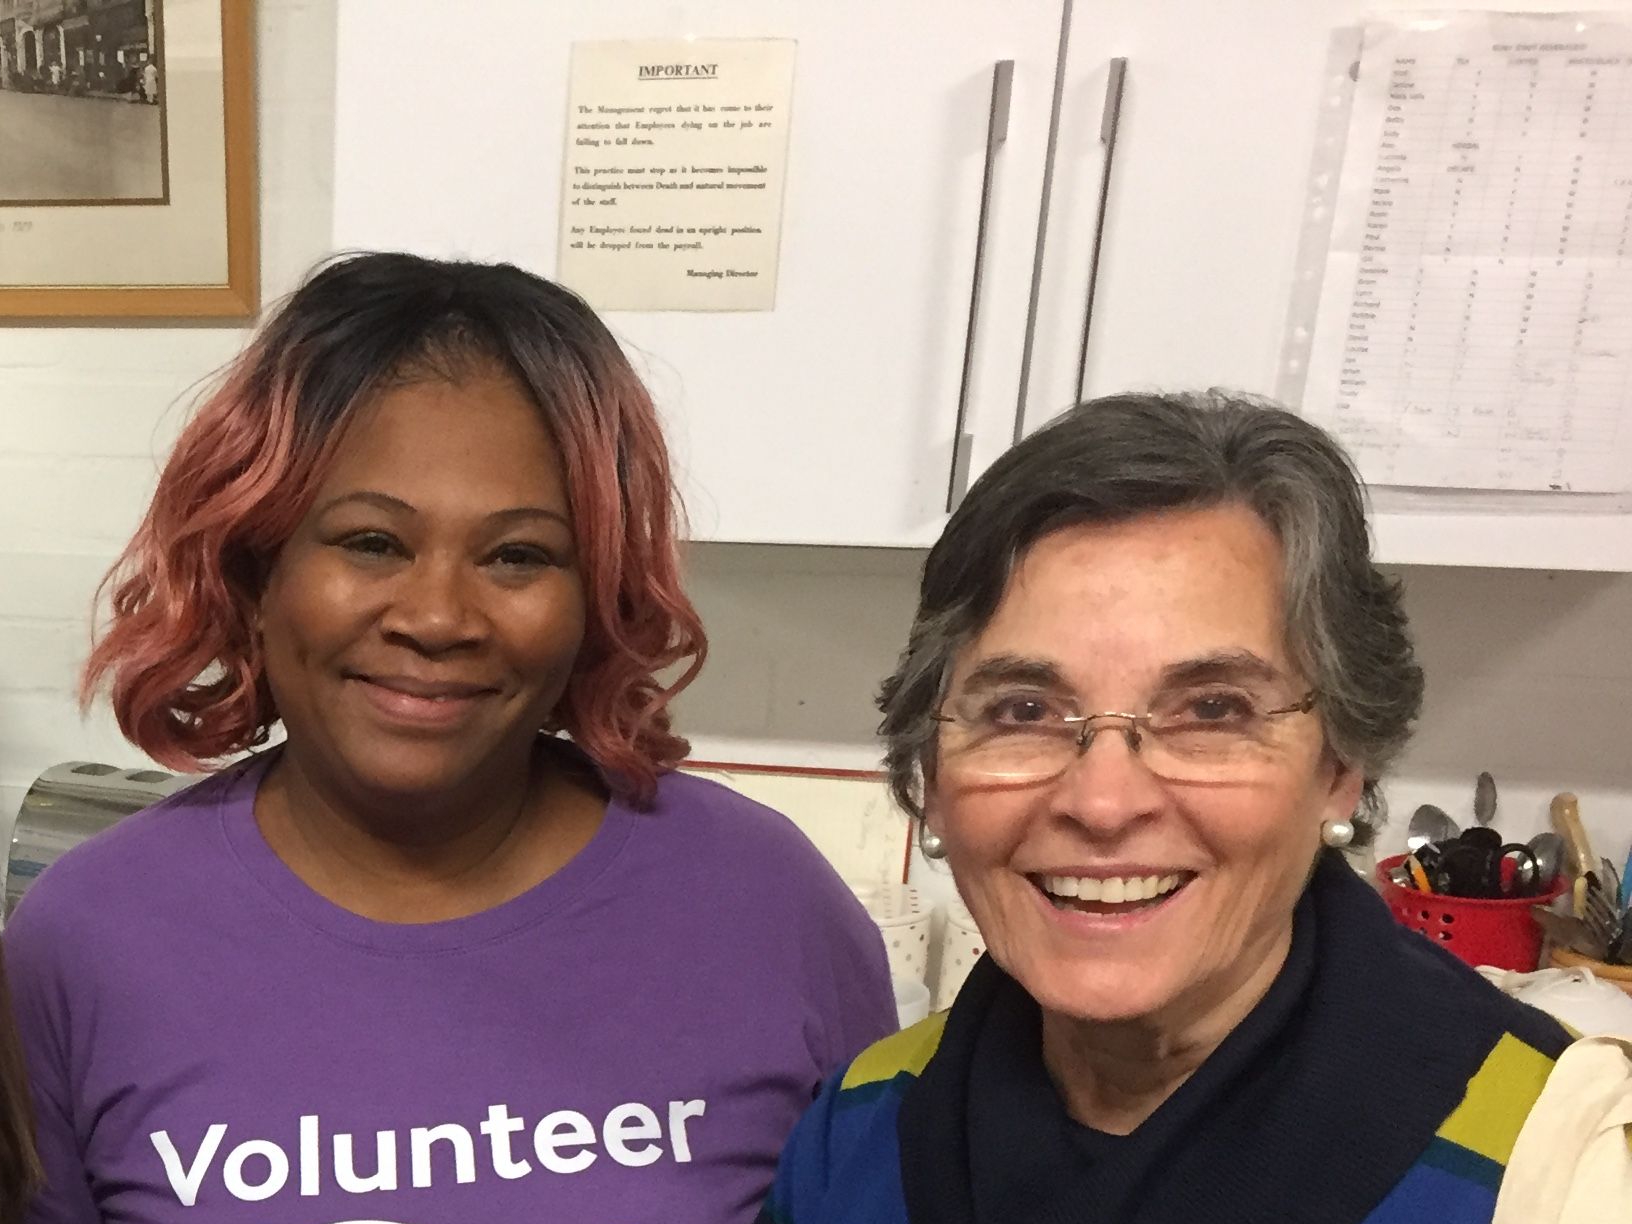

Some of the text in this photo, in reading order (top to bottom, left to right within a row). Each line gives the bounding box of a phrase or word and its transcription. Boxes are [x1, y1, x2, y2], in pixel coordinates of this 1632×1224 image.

[637, 63, 719, 78] IMPORTANT
[578, 105, 593, 114] The
[597, 105, 645, 116] Management
[676, 104, 692, 113] that
[755, 103, 774, 112] their
[615, 121, 630, 129] that
[681, 120, 703, 131] dying
[723, 120, 736, 128] the
[739, 120, 753, 131] job
[574, 166, 590, 175] This
[571, 198, 581, 206] of
[583, 198, 596, 206] the
[587, 241, 596, 249] be
[657, 240, 670, 249] the
[686, 269, 759, 280] Managing Director
[149, 1098, 706, 1207] Volunteer
